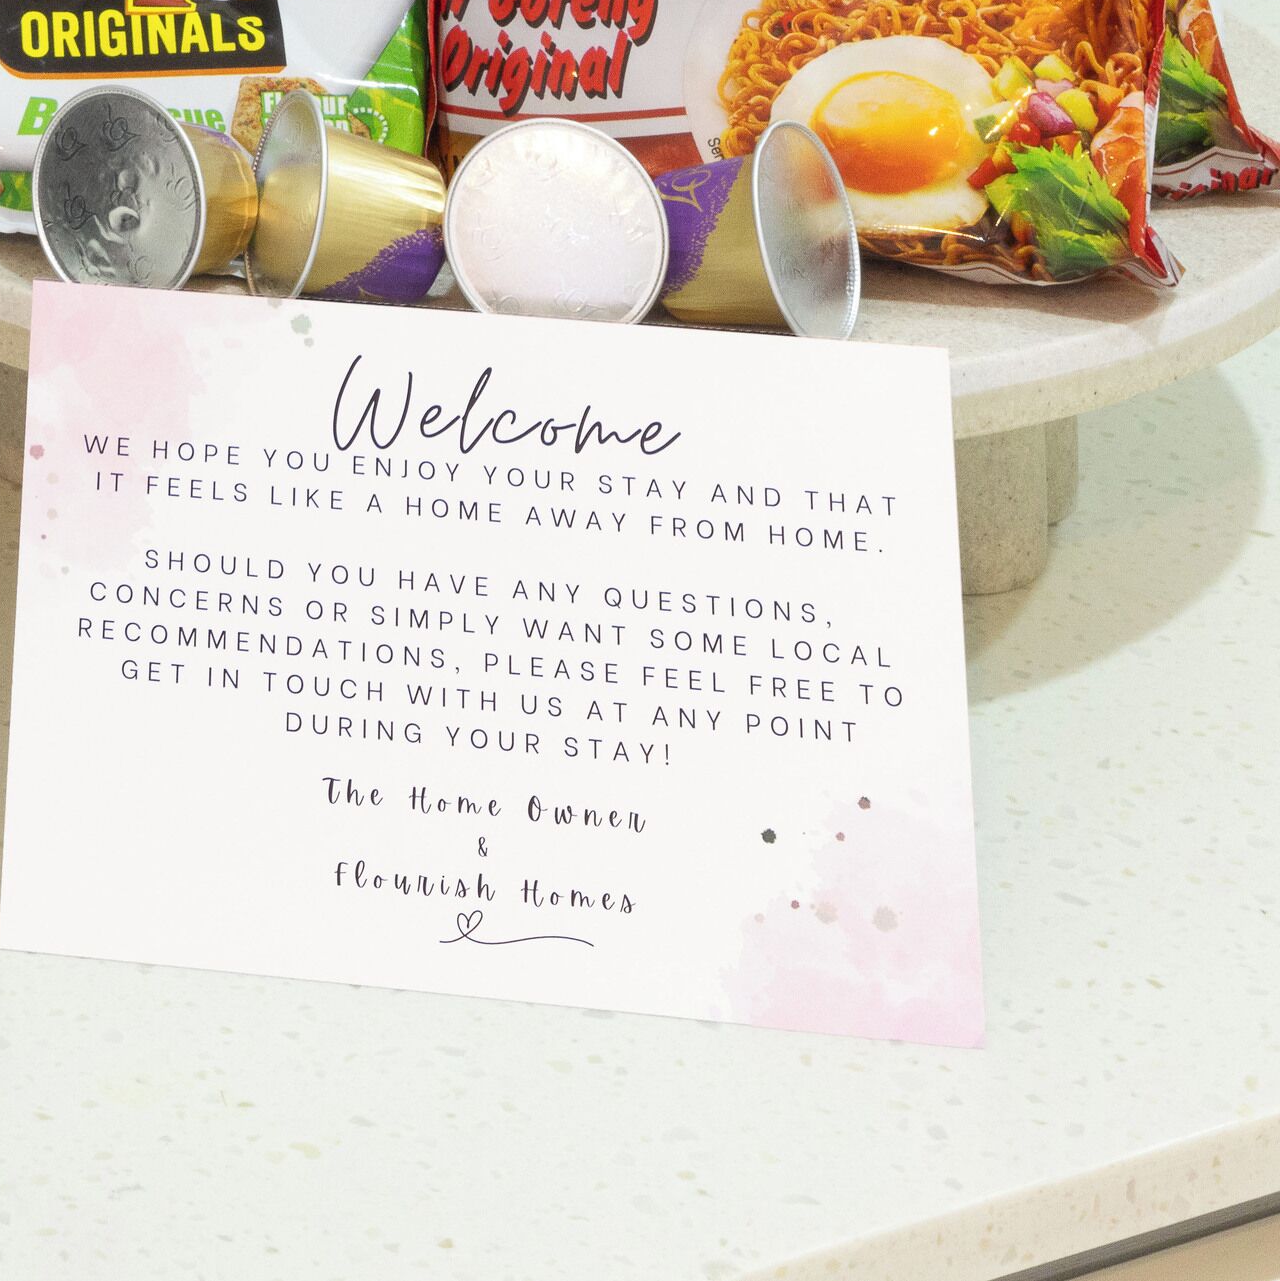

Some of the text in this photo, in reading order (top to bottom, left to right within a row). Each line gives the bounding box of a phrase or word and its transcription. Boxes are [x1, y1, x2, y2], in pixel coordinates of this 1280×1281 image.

[19, 8, 266, 59] ORIGINALS
[441, 24, 633, 118] Original
[331, 353, 682, 456] Welcome
[83, 434, 896, 516] WE HOPE YOU ENJOY YOUR STAY AND THAT
[96, 471, 885, 553] IT FEELS LIKE A HOME AWAY FROM HOME.
[90, 581, 891, 668] CONCERNS OR SIMPLY WANT SOME LOCAL
[145, 549, 834, 628] SHOULD YOU HAVE ANY QUESTIONS,
[78, 617, 903, 707] RECOMMENDATIONS, PLEASE FEEL FREE TO
[121, 659, 856, 742] GET IN TOUCH WITH US AT ANY POINT
[286, 711, 672, 766] DURING YOUR STAY!
[321, 777, 647, 835] The Home Owner
[477, 836, 489, 858] &
[333, 860, 638, 915] Flourish Homes
